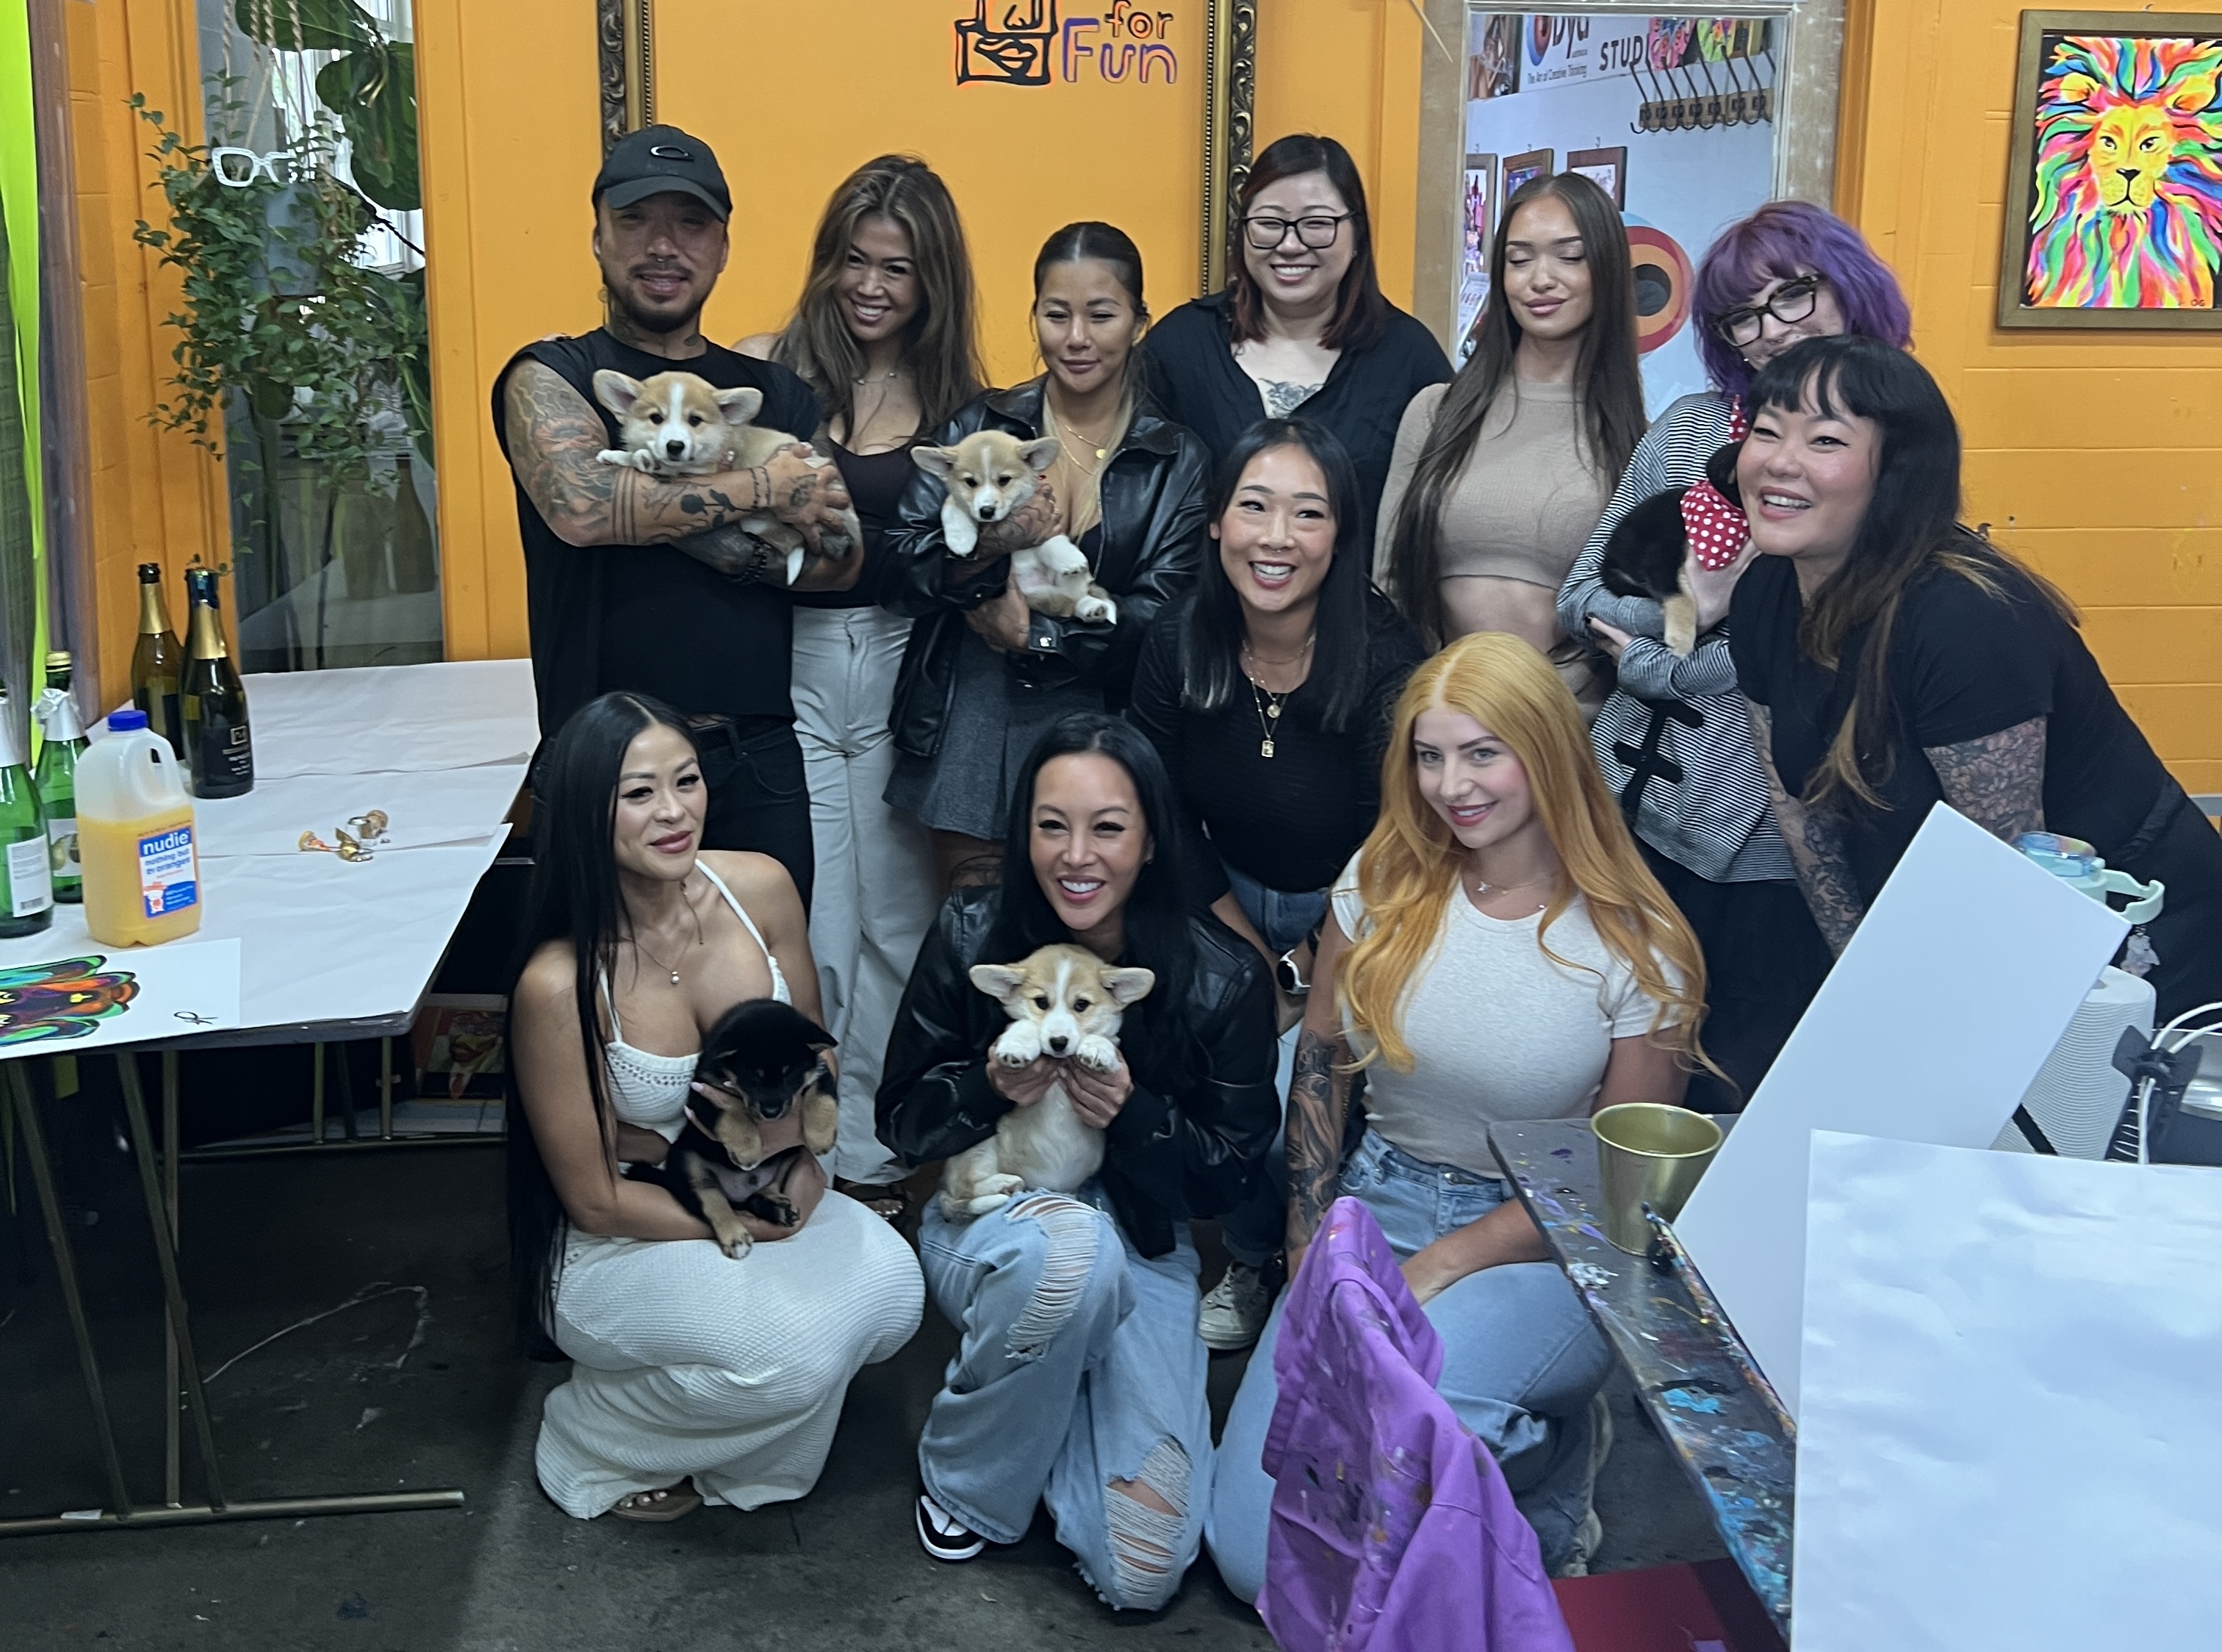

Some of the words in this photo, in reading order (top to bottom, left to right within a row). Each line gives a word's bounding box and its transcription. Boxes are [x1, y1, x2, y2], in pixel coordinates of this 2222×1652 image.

[1104, 0, 1173, 39] for
[1063, 18, 1176, 84] Fun
[143, 832, 189, 855] nudie
